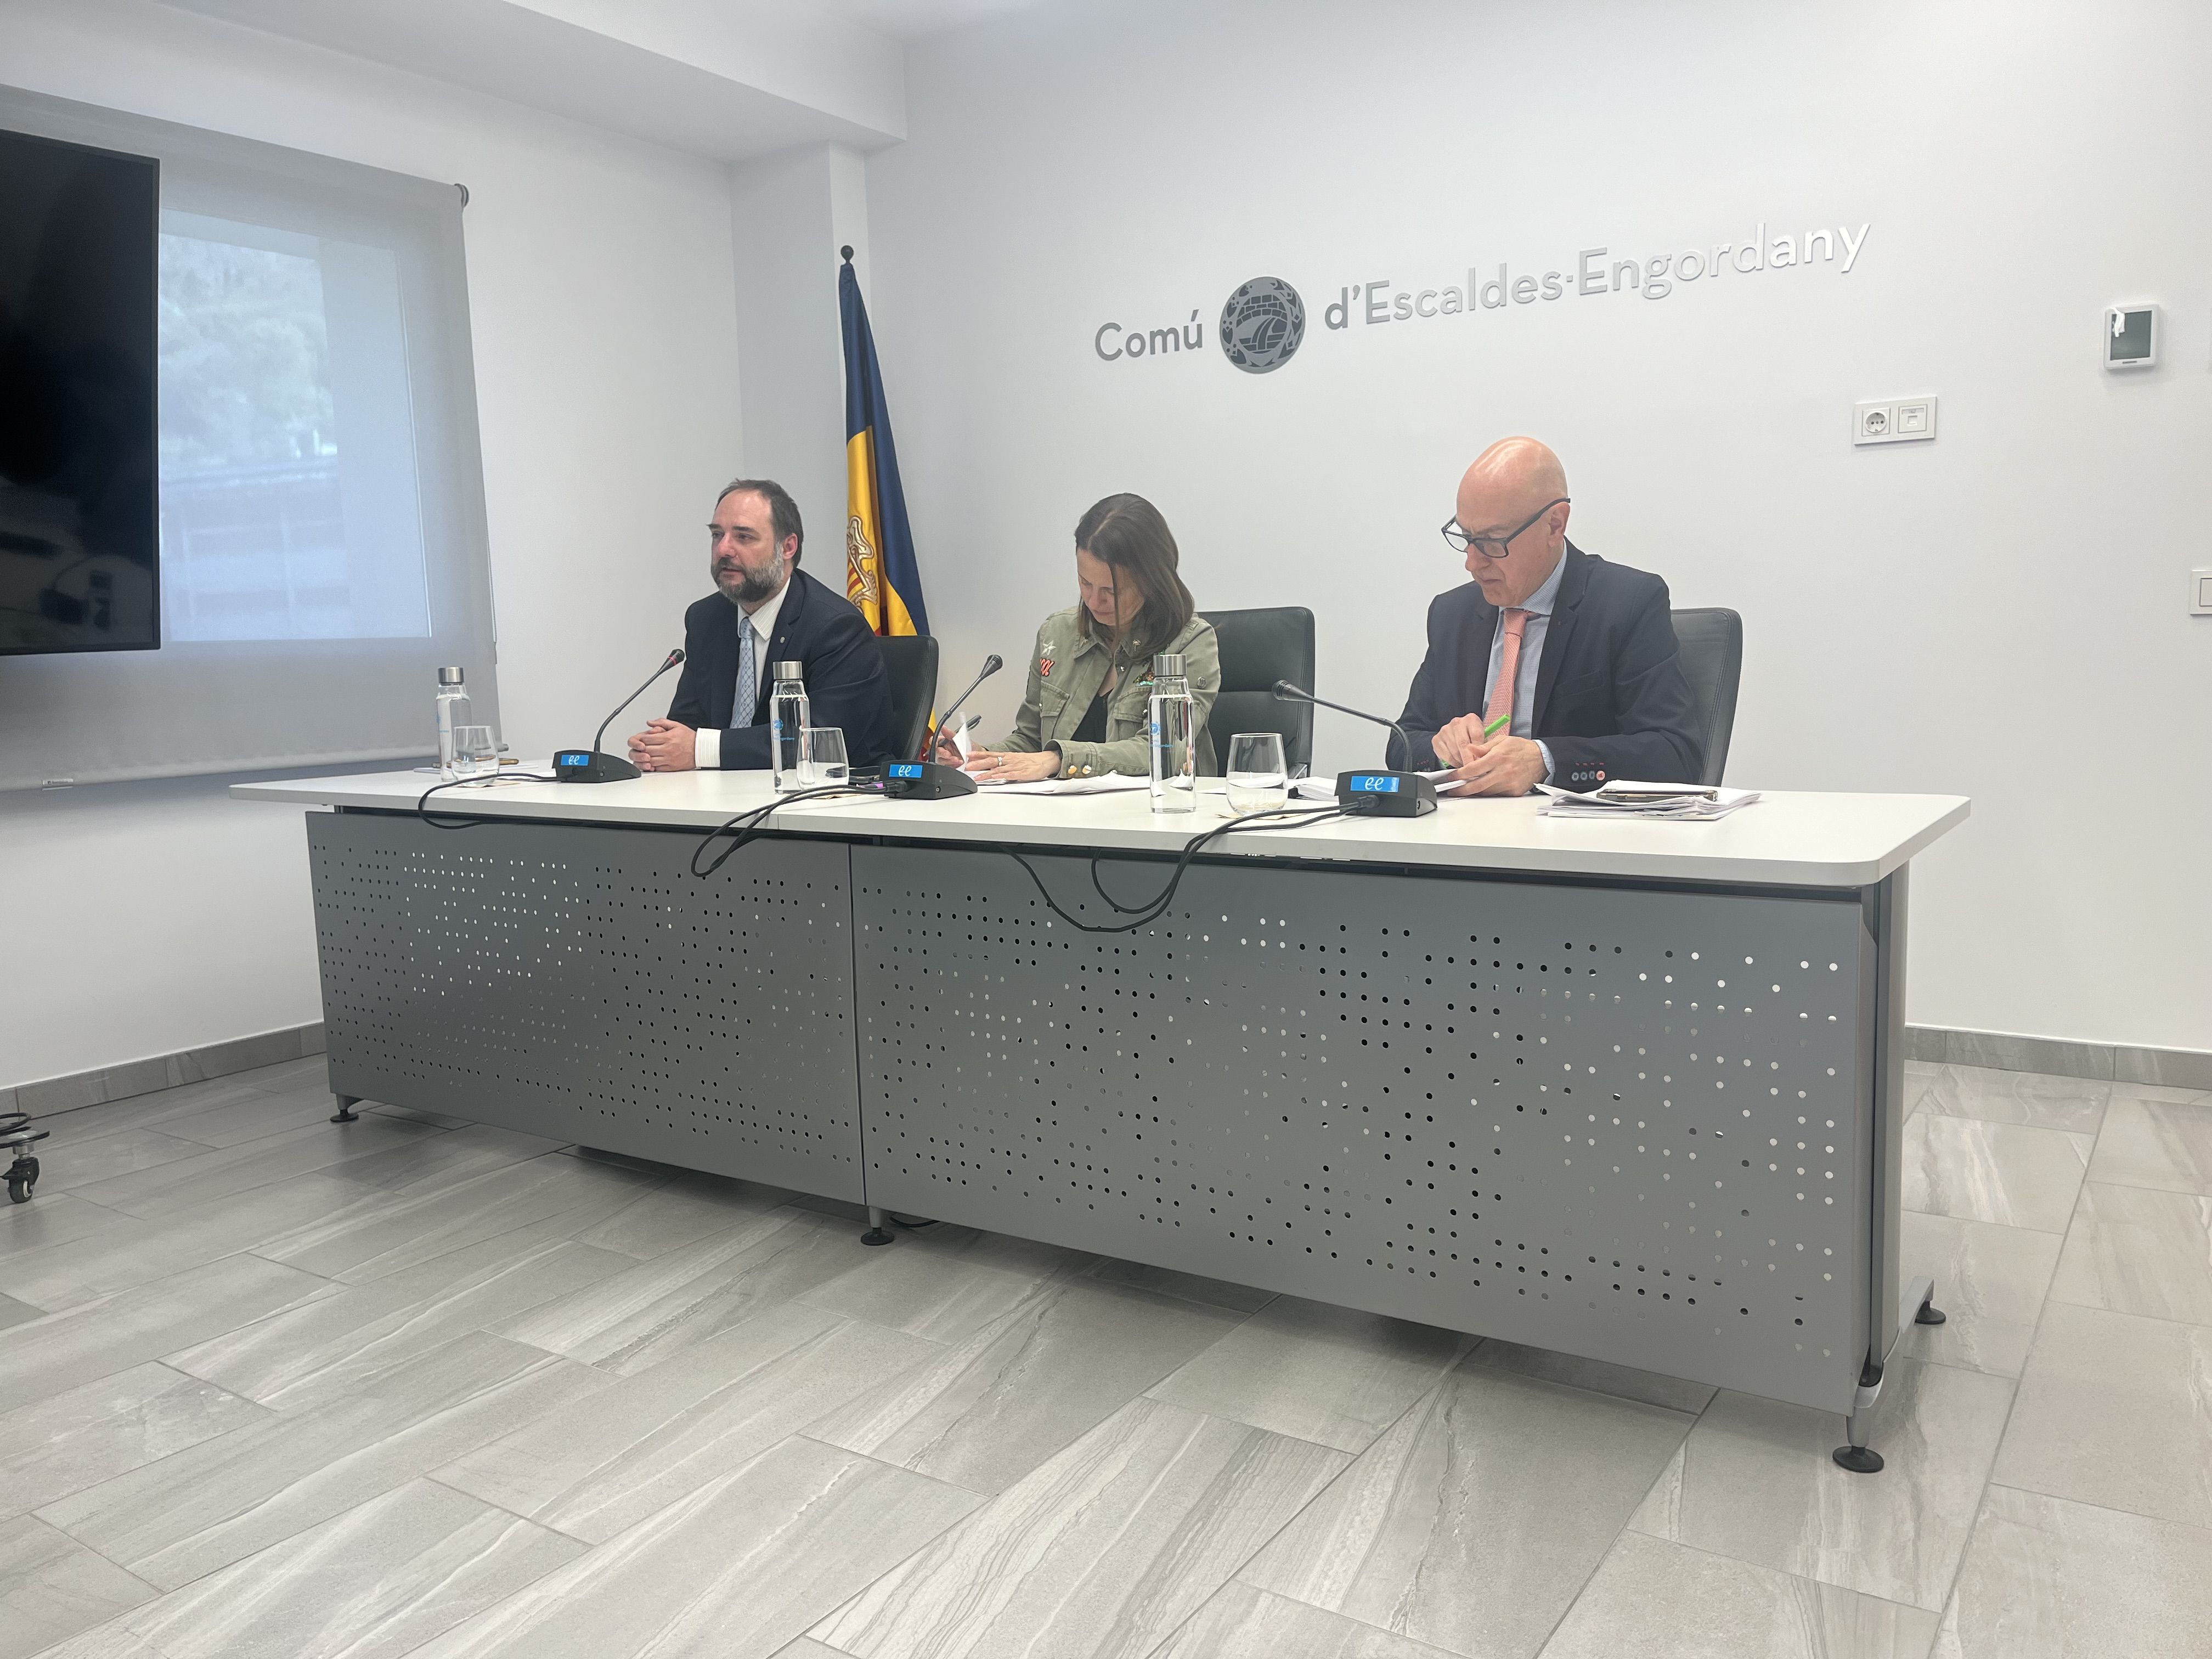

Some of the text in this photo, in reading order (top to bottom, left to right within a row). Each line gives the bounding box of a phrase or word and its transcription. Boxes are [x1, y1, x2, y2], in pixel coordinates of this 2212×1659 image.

[1095, 309, 1203, 361] Comú
[568, 755, 580, 765] ee
[898, 765, 912, 776] ee
[1364, 777, 1384, 791] ee
